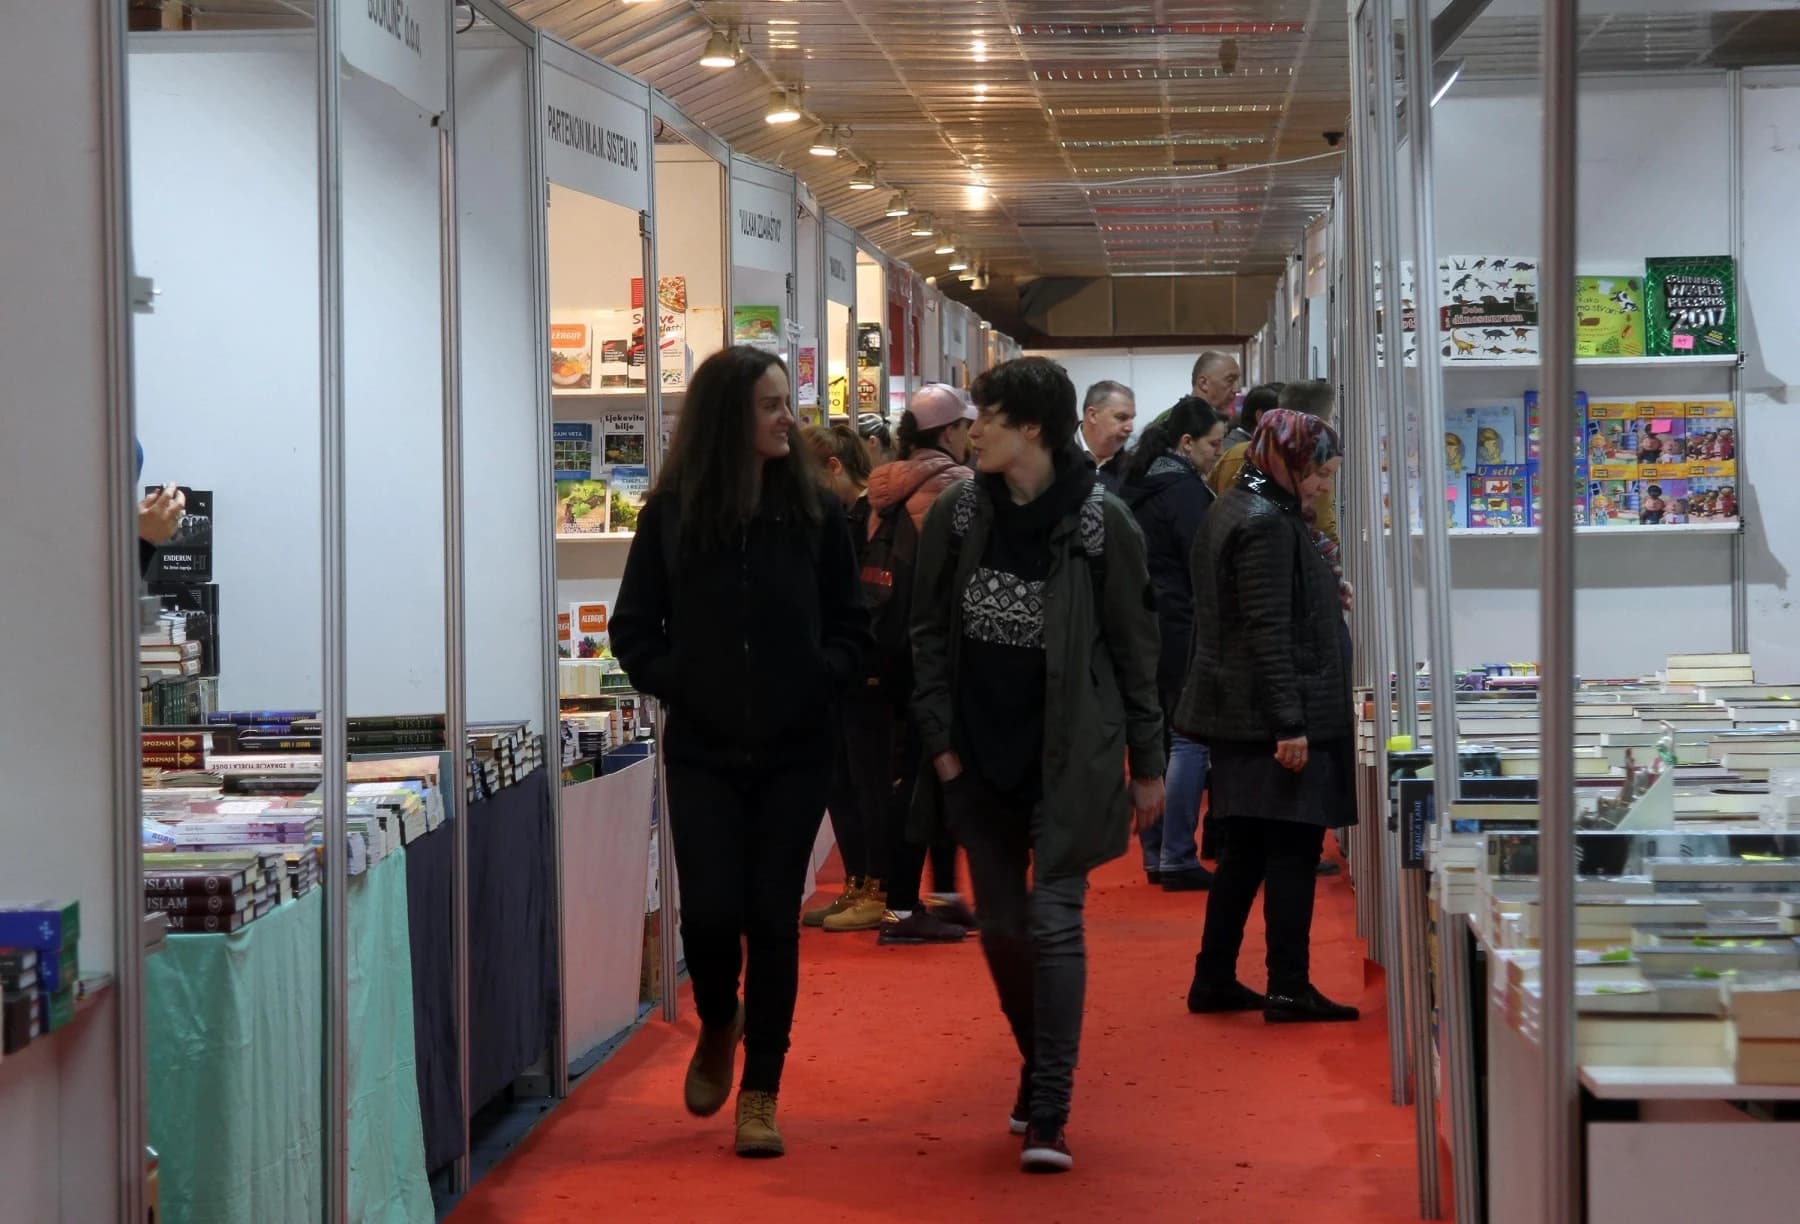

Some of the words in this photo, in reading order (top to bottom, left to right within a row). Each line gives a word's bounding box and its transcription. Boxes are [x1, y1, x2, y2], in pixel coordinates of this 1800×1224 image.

[547, 105, 584, 151] PARTENON
[606, 130, 629, 169] SISTEM
[629, 140, 639, 171] AD
[1666, 275, 1722, 285] GUINNESS
[1666, 284, 1724, 297] WORLD
[1667, 297, 1726, 308] RECORDS
[1669, 307, 1727, 331] 2017
[163, 554, 192, 562] ENDERUN
[142, 740, 176, 748] SPOZNAJA
[142, 756, 176, 764] SPOZNAJA
[1414, 800, 1422, 821] LANE
[1414, 824, 1423, 860] JAMAICA
[147, 897, 188, 909] ISLAM
